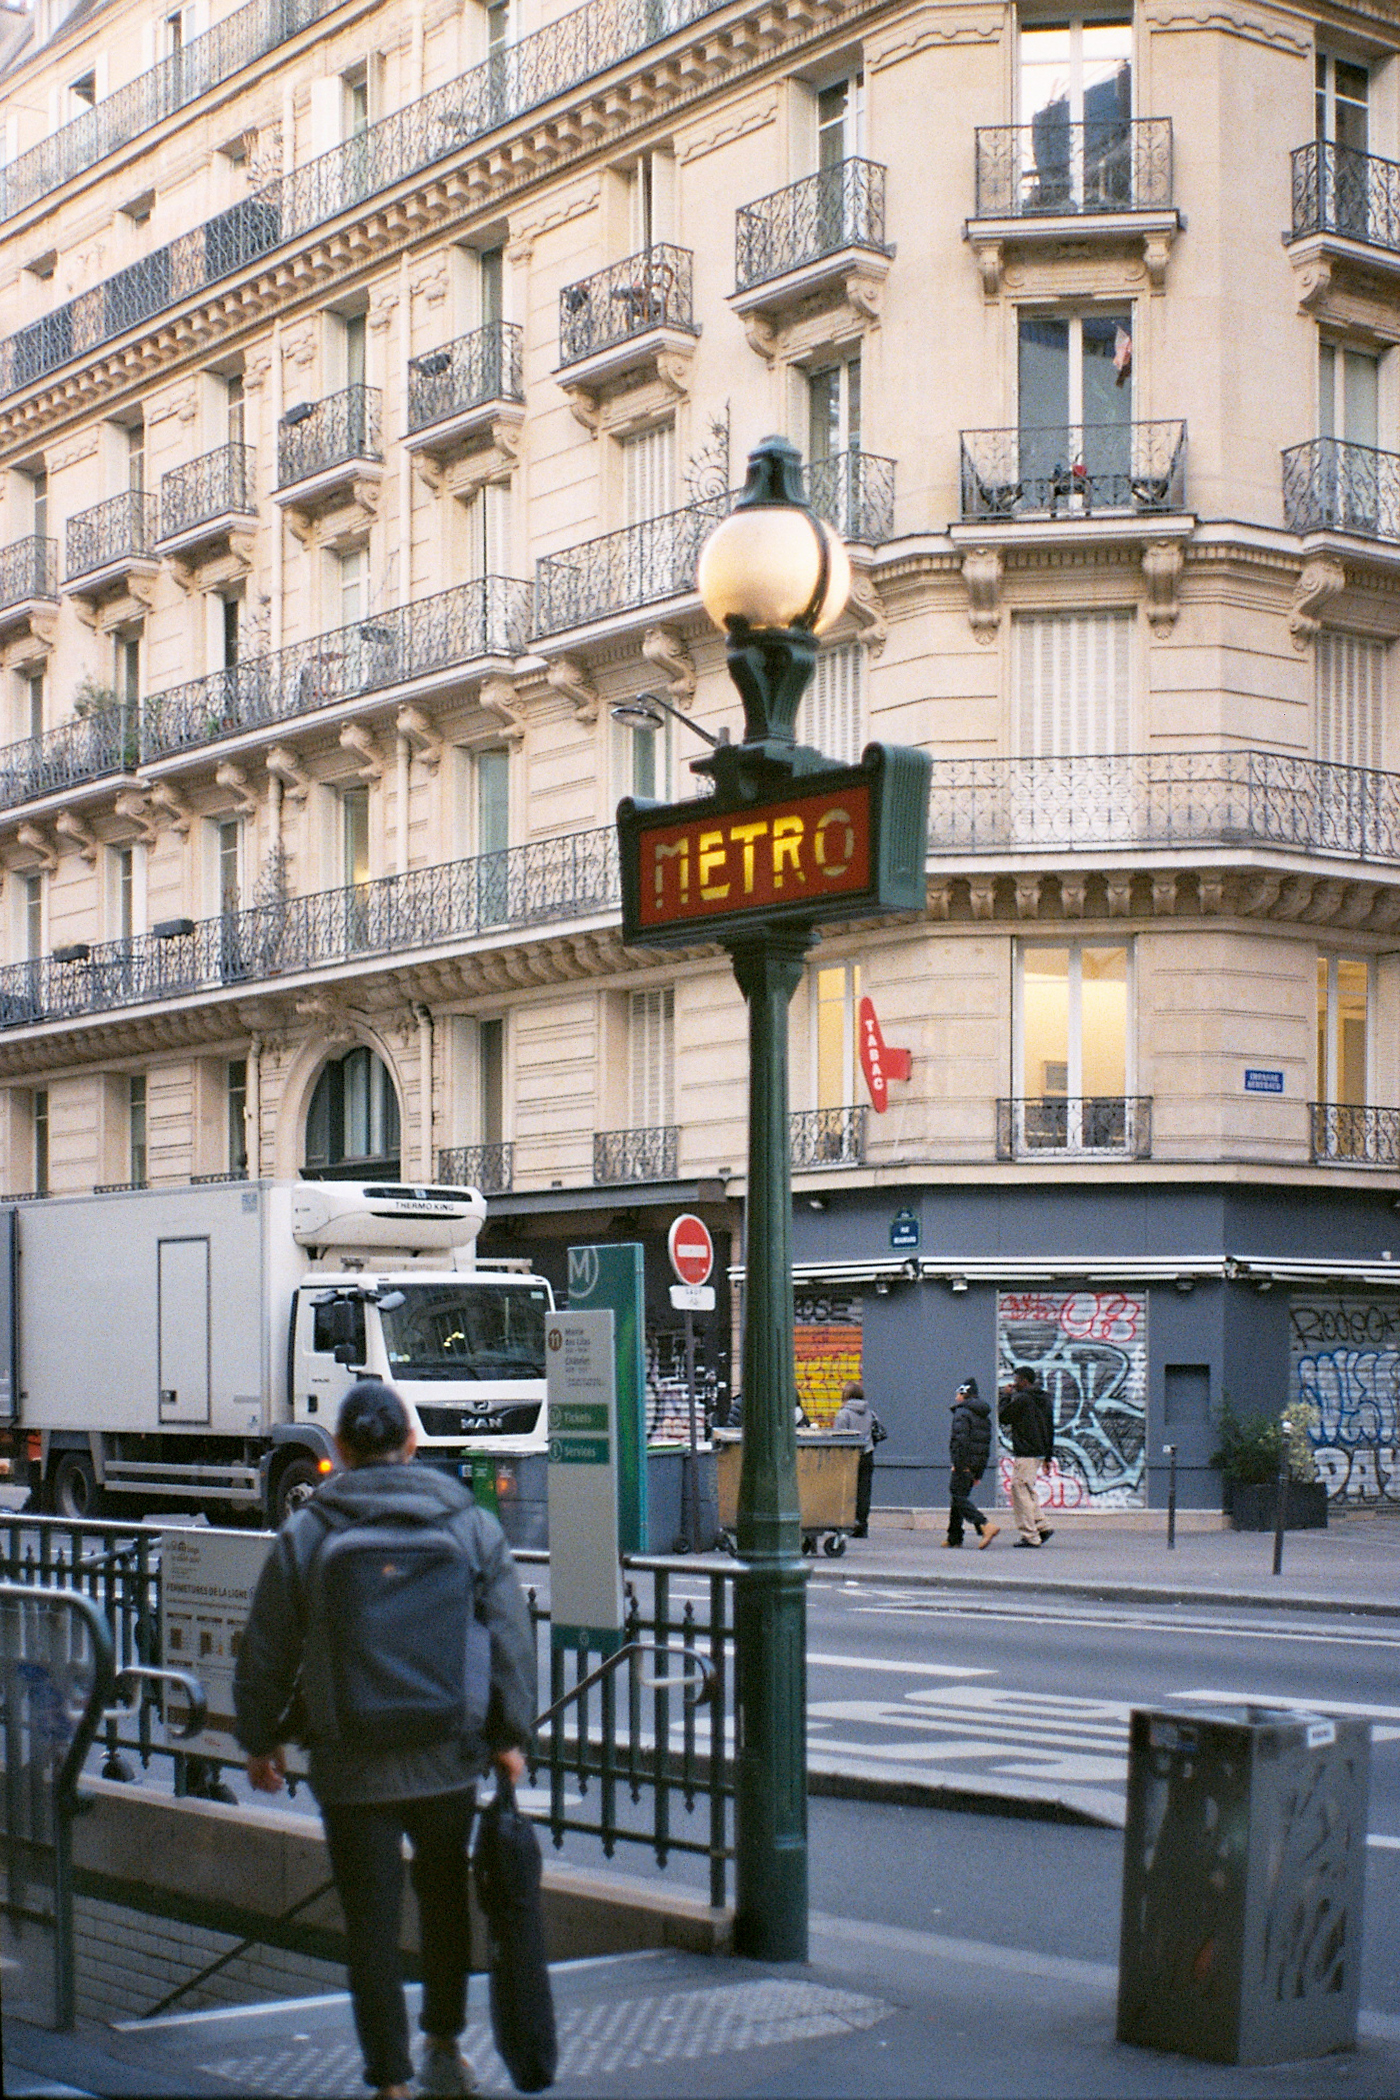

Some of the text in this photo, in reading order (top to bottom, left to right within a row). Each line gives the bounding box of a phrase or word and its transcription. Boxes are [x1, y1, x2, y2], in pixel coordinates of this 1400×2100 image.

[864, 1019, 884, 1090] TABAC
[396, 1201, 455, 1211] THERMO KING
[551, 1333, 560, 1346] 11
[460, 1417, 502, 1429] MAN
